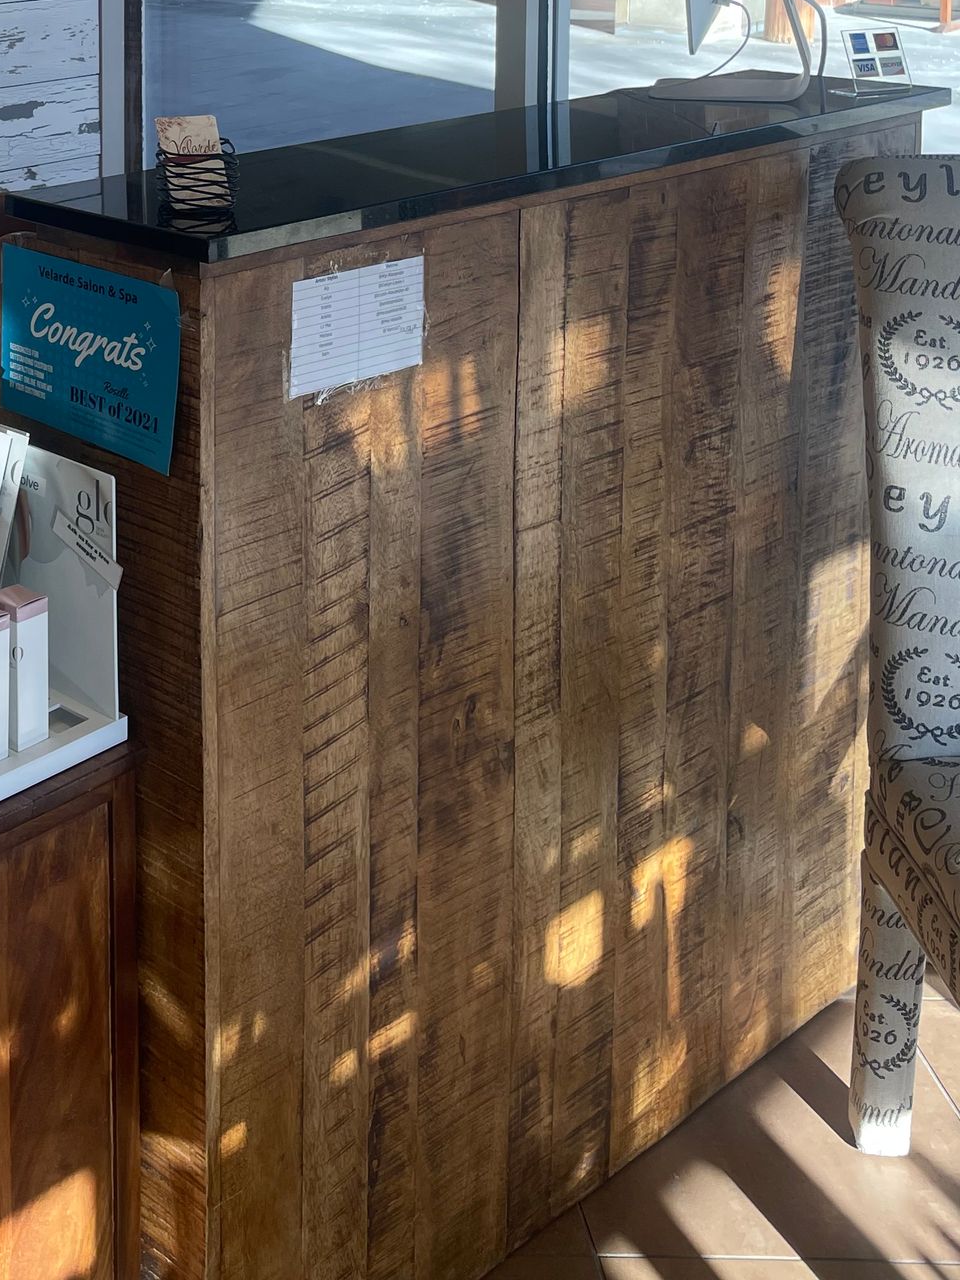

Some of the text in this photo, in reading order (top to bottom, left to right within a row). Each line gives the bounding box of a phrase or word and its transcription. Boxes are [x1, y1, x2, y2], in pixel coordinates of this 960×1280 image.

[857, 63, 876, 73] VISA
[38, 265, 138, 304] Velarde Salon & Spa
[30, 302, 145, 372] Congrats
[913, 329, 951, 350] Est.
[69, 385, 106, 413] BEST
[108, 401, 124, 419] of
